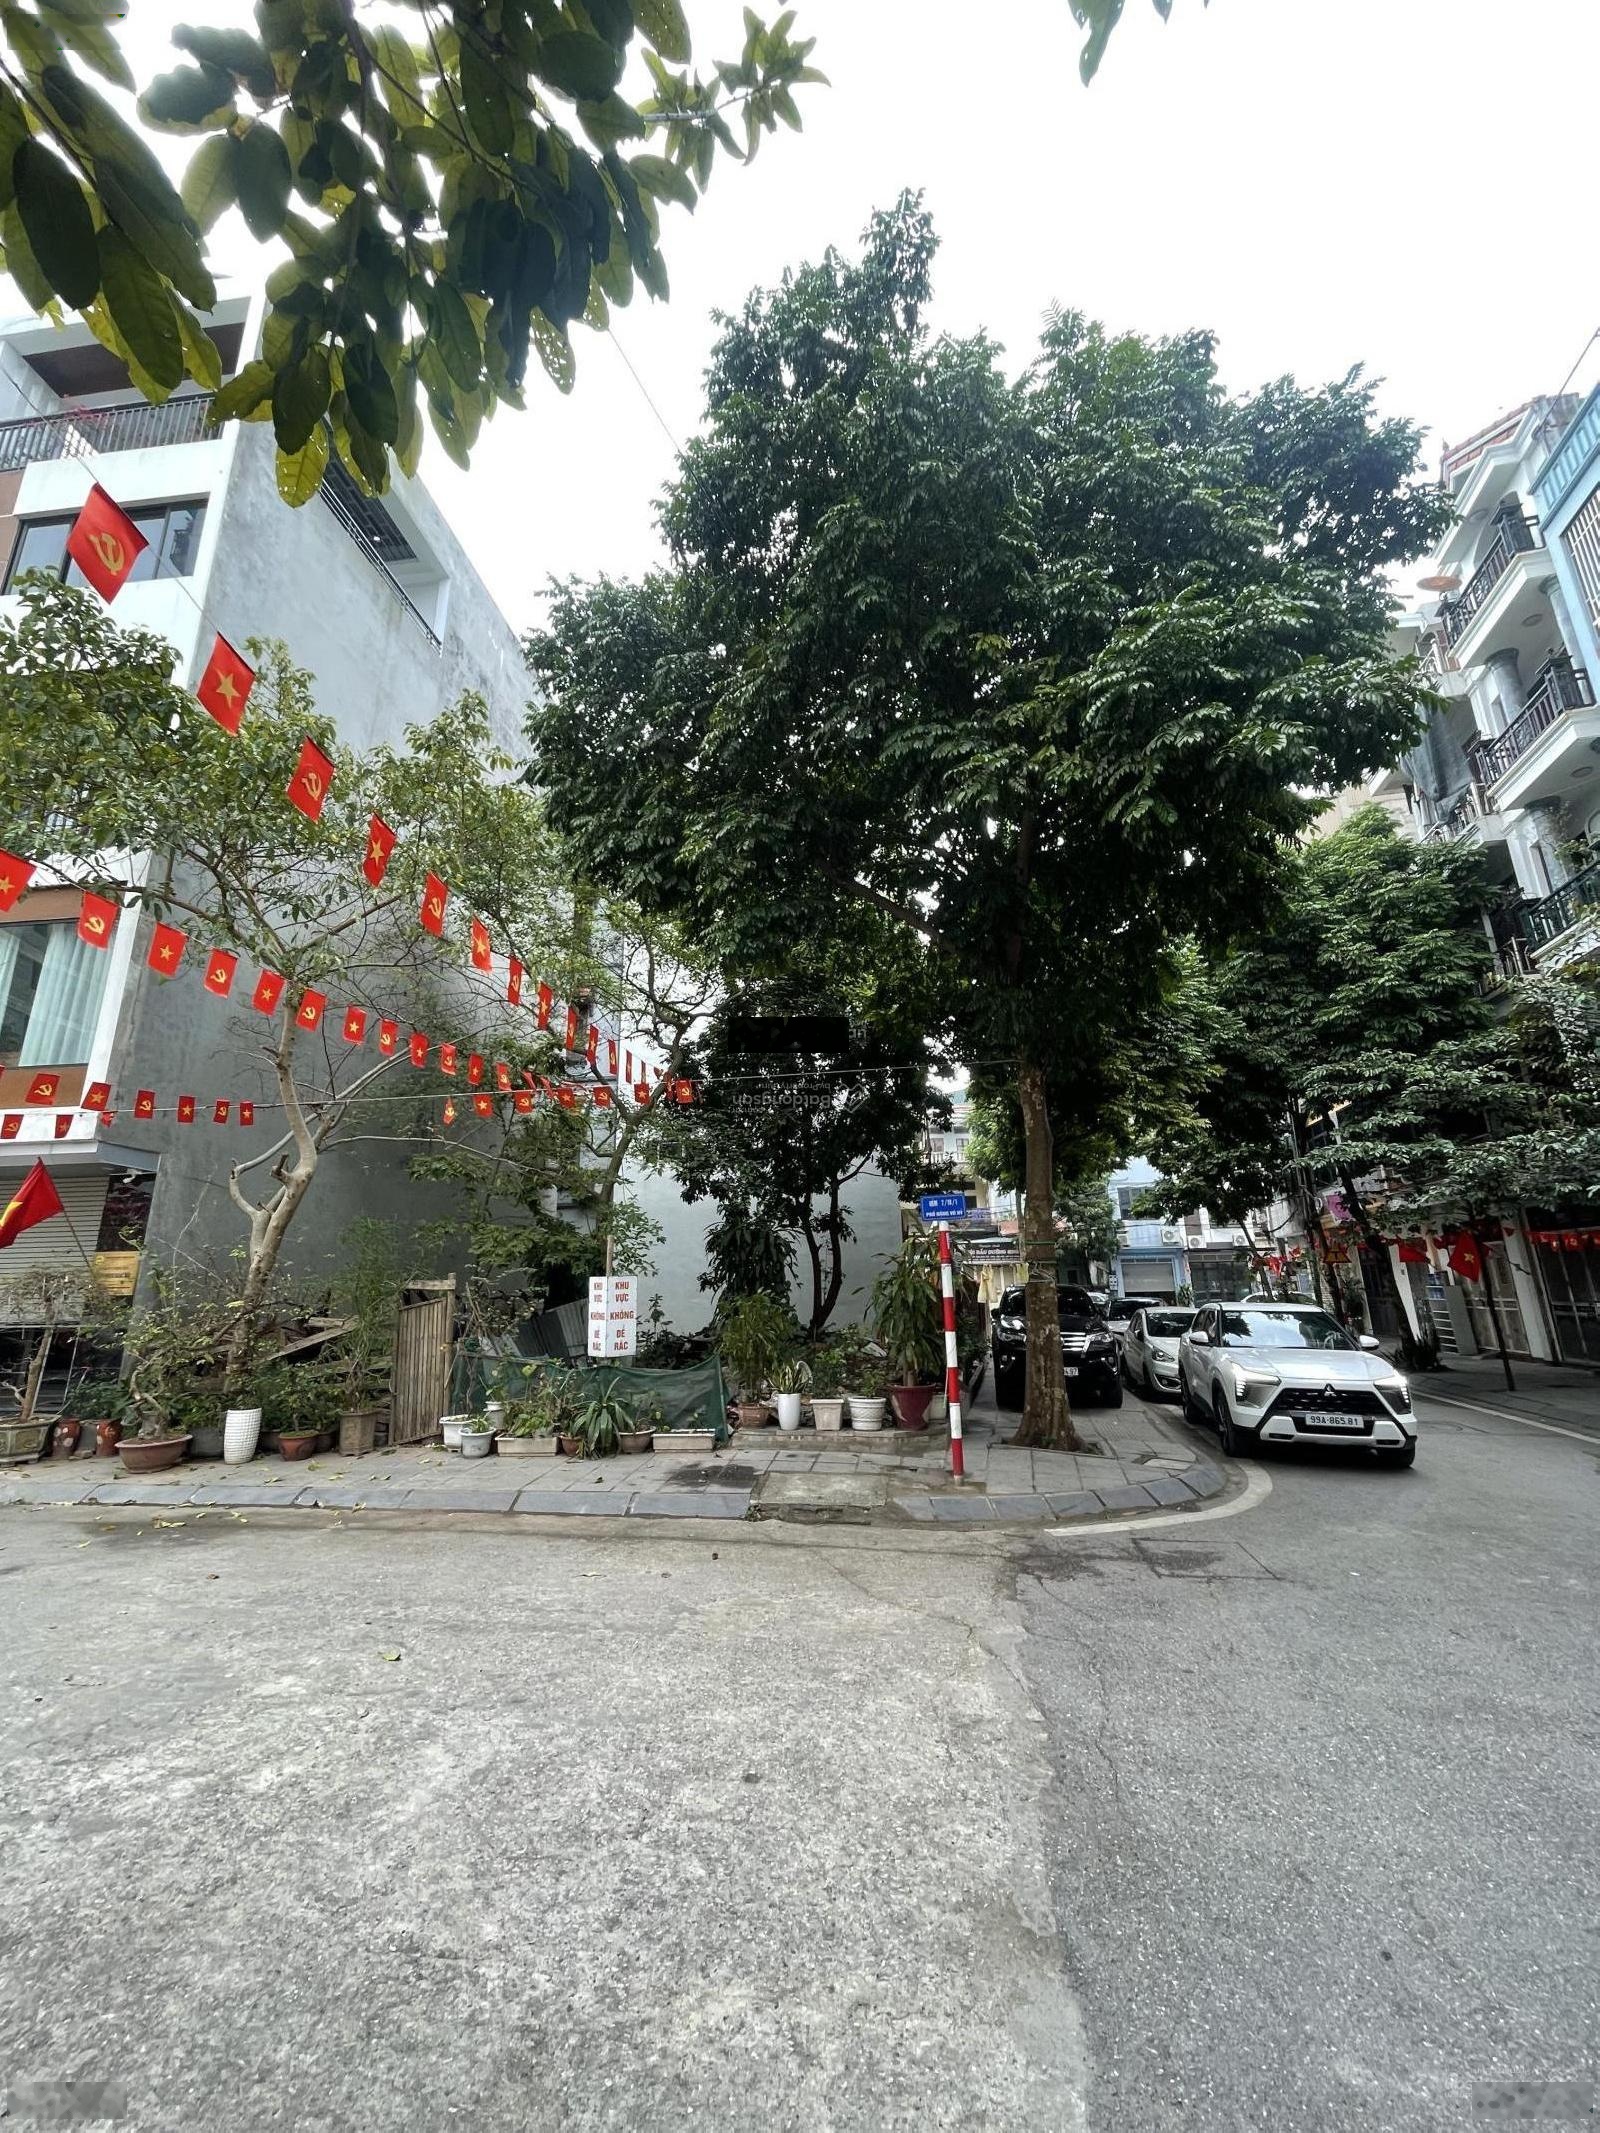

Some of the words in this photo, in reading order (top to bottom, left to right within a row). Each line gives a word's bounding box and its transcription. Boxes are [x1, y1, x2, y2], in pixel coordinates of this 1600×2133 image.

[615, 1281, 629, 1290] KHU
[615, 1292, 629, 1303] VỰC
[610, 1309, 634, 1321] KHÔNG
[614, 1339, 629, 1351] RÁC
